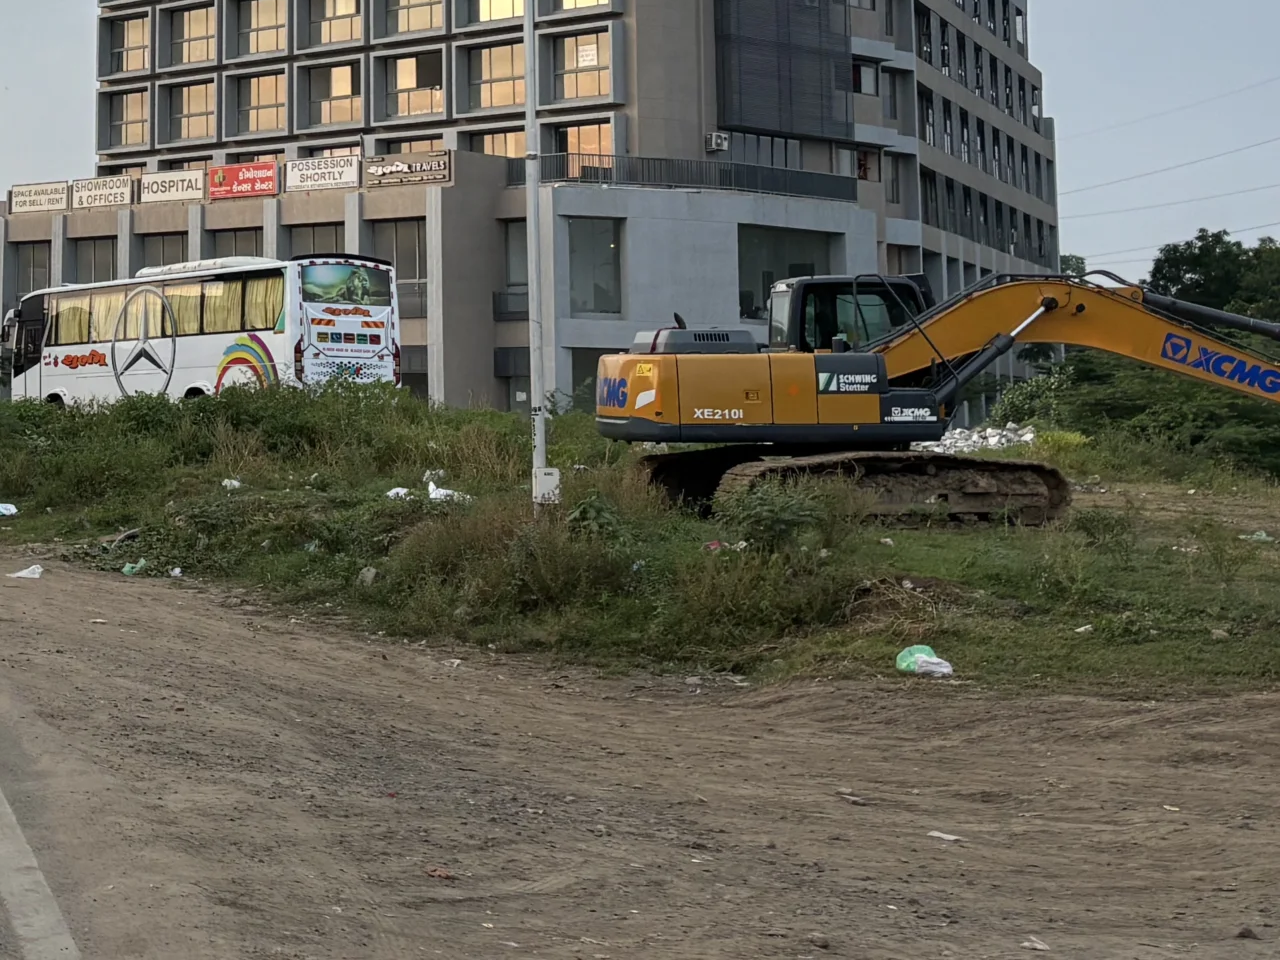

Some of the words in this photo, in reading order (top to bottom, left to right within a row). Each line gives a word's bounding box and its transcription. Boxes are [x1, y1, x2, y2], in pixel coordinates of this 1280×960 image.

[291, 158, 353, 172] POSSESSION
[411, 160, 445, 172] TRAVELS
[299, 171, 344, 183] SHORTLY
[74, 177, 129, 193] SHOWROOM
[142, 178, 202, 194] HOSPITAL
[13, 190, 33, 199] SPACE
[33, 187, 66, 197] AVAILABLE
[77, 196, 84, 206] &
[86, 192, 125, 205] OFFICES
[15, 199, 27, 208] FOR
[28, 198, 43, 207] SELL
[47, 197, 63, 206] RENT
[1186, 345, 1280, 394] XCMG
[839, 374, 877, 383] SCHWING
[839, 383, 869, 392] Stetter
[901, 408, 931, 416] XCMG
